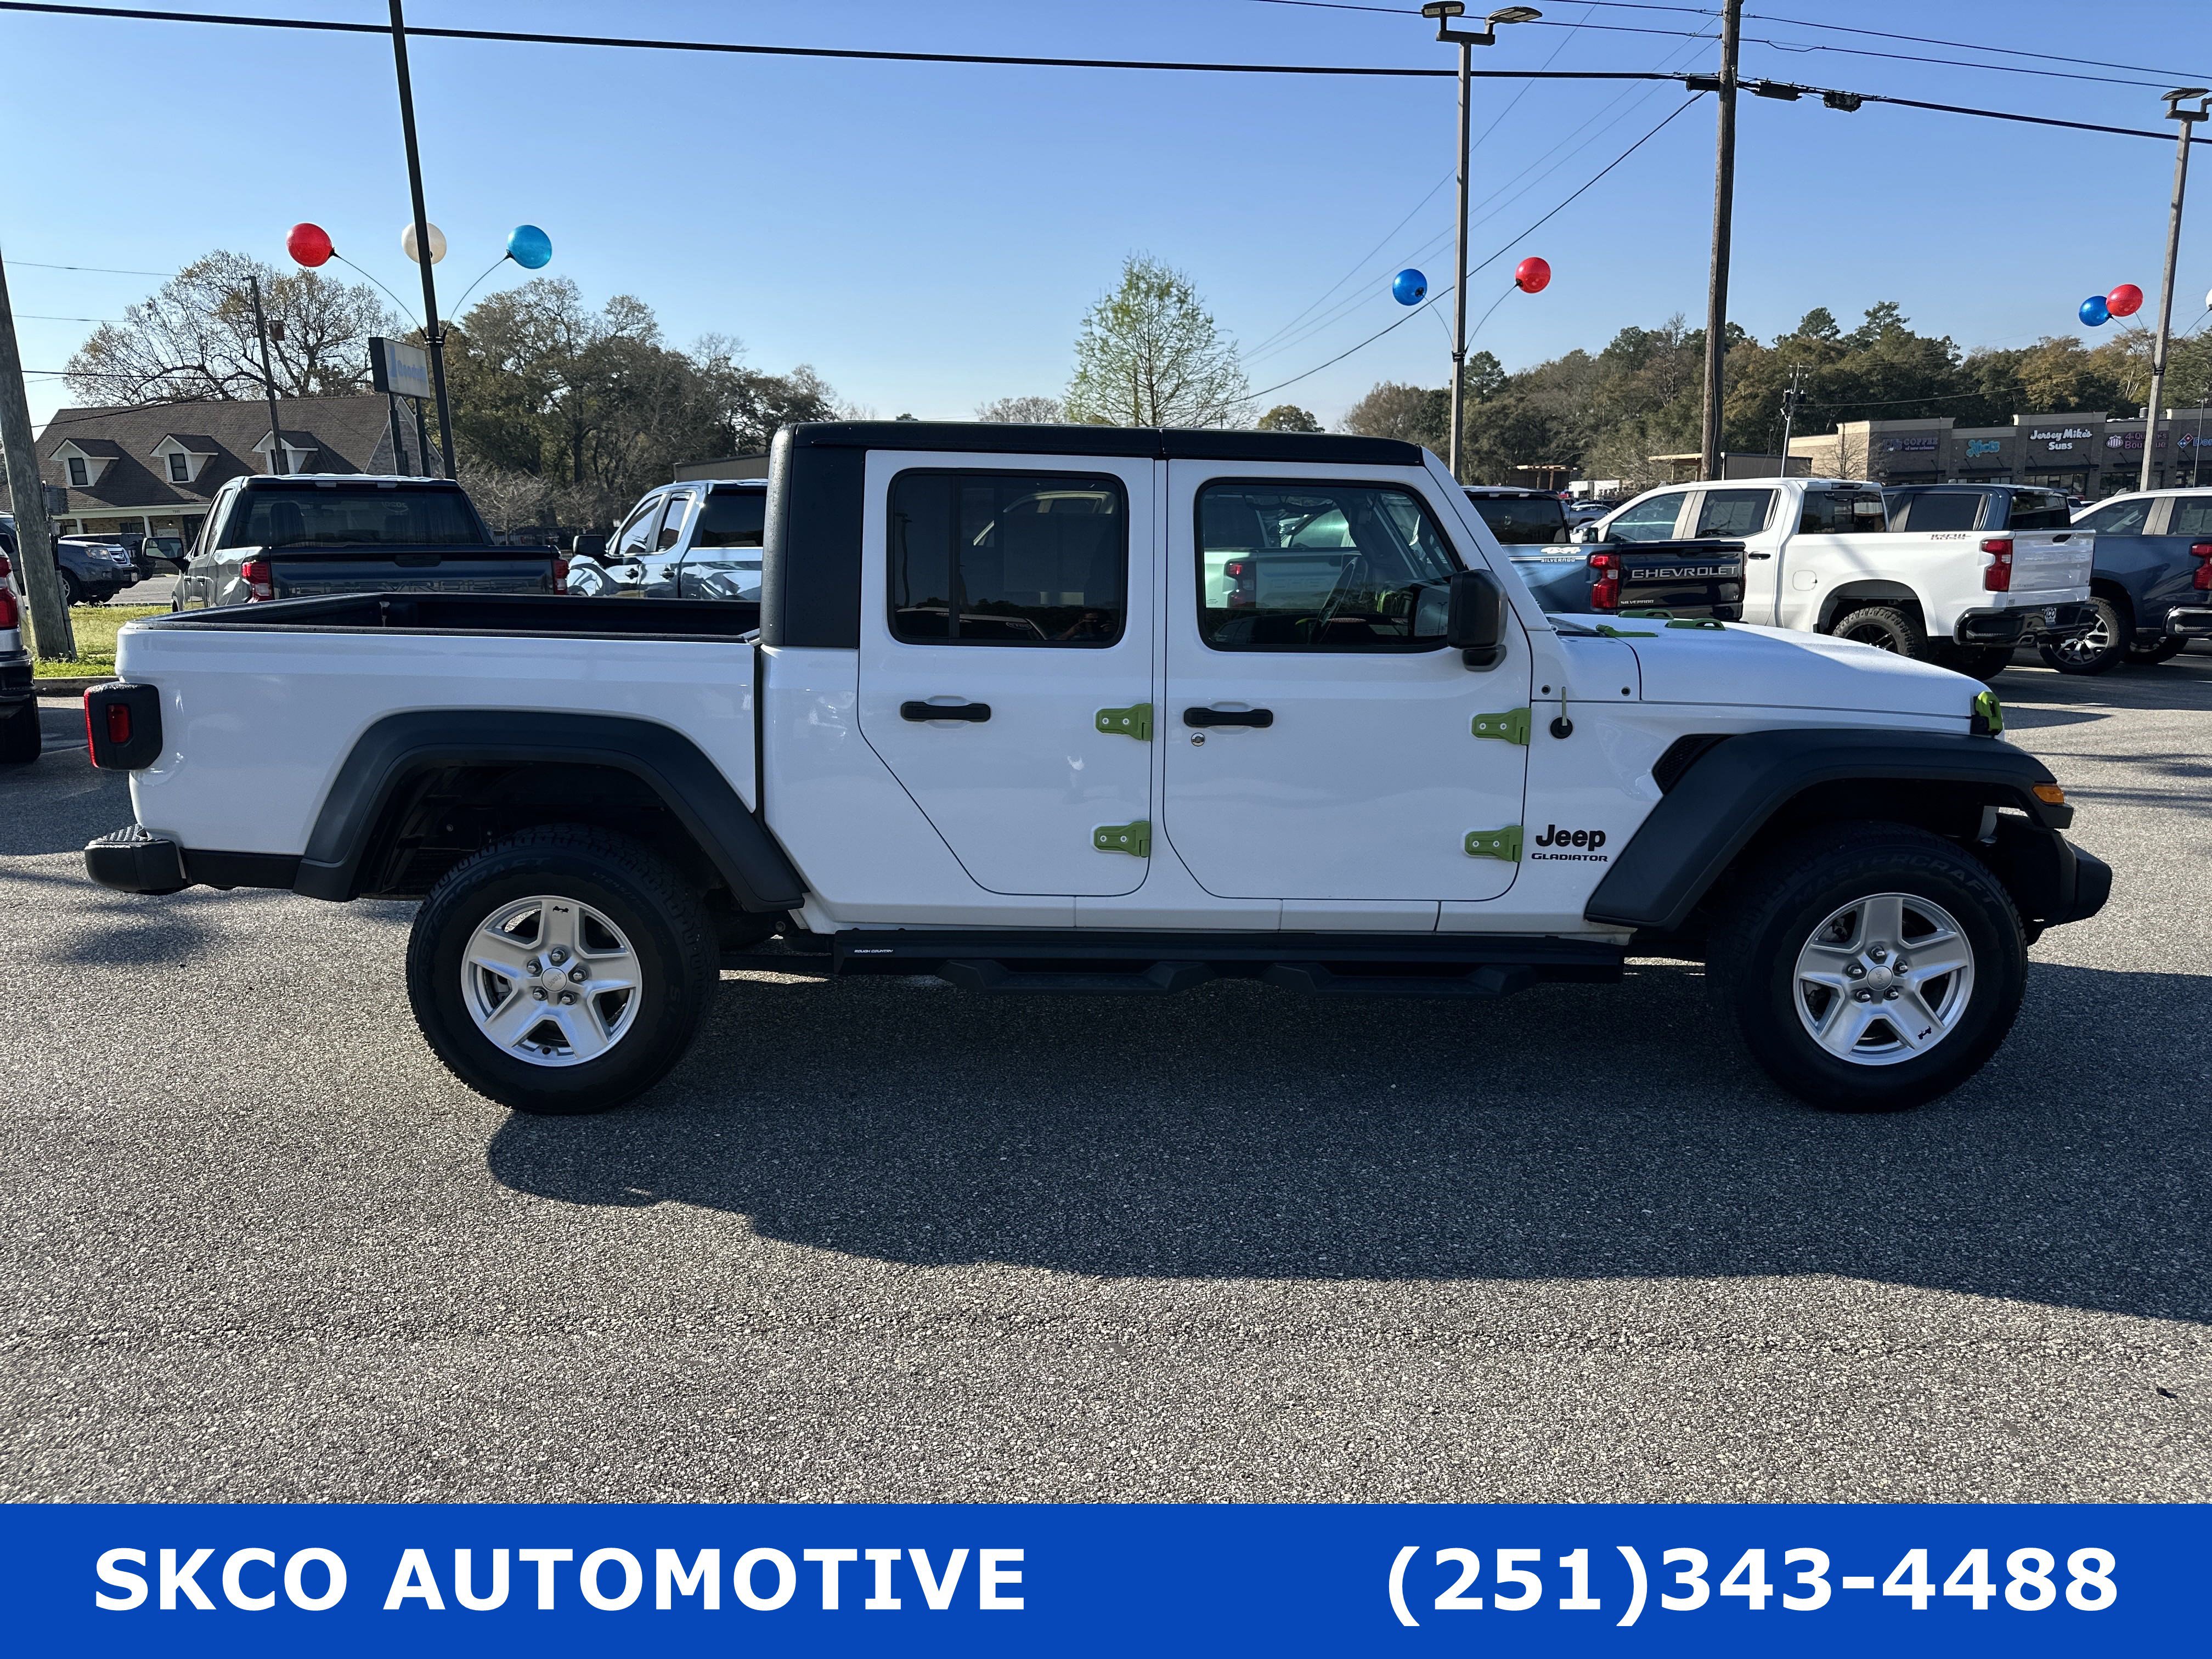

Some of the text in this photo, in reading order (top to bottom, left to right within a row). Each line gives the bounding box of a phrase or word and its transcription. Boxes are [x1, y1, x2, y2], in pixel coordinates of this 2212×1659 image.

[2030, 428, 2093, 441] Jersey Mike's
[1632, 566, 1737, 579] CHEVROLET
[1536, 824, 1606, 852] Jeep
[1531, 853, 1608, 862] GLADIATOR
